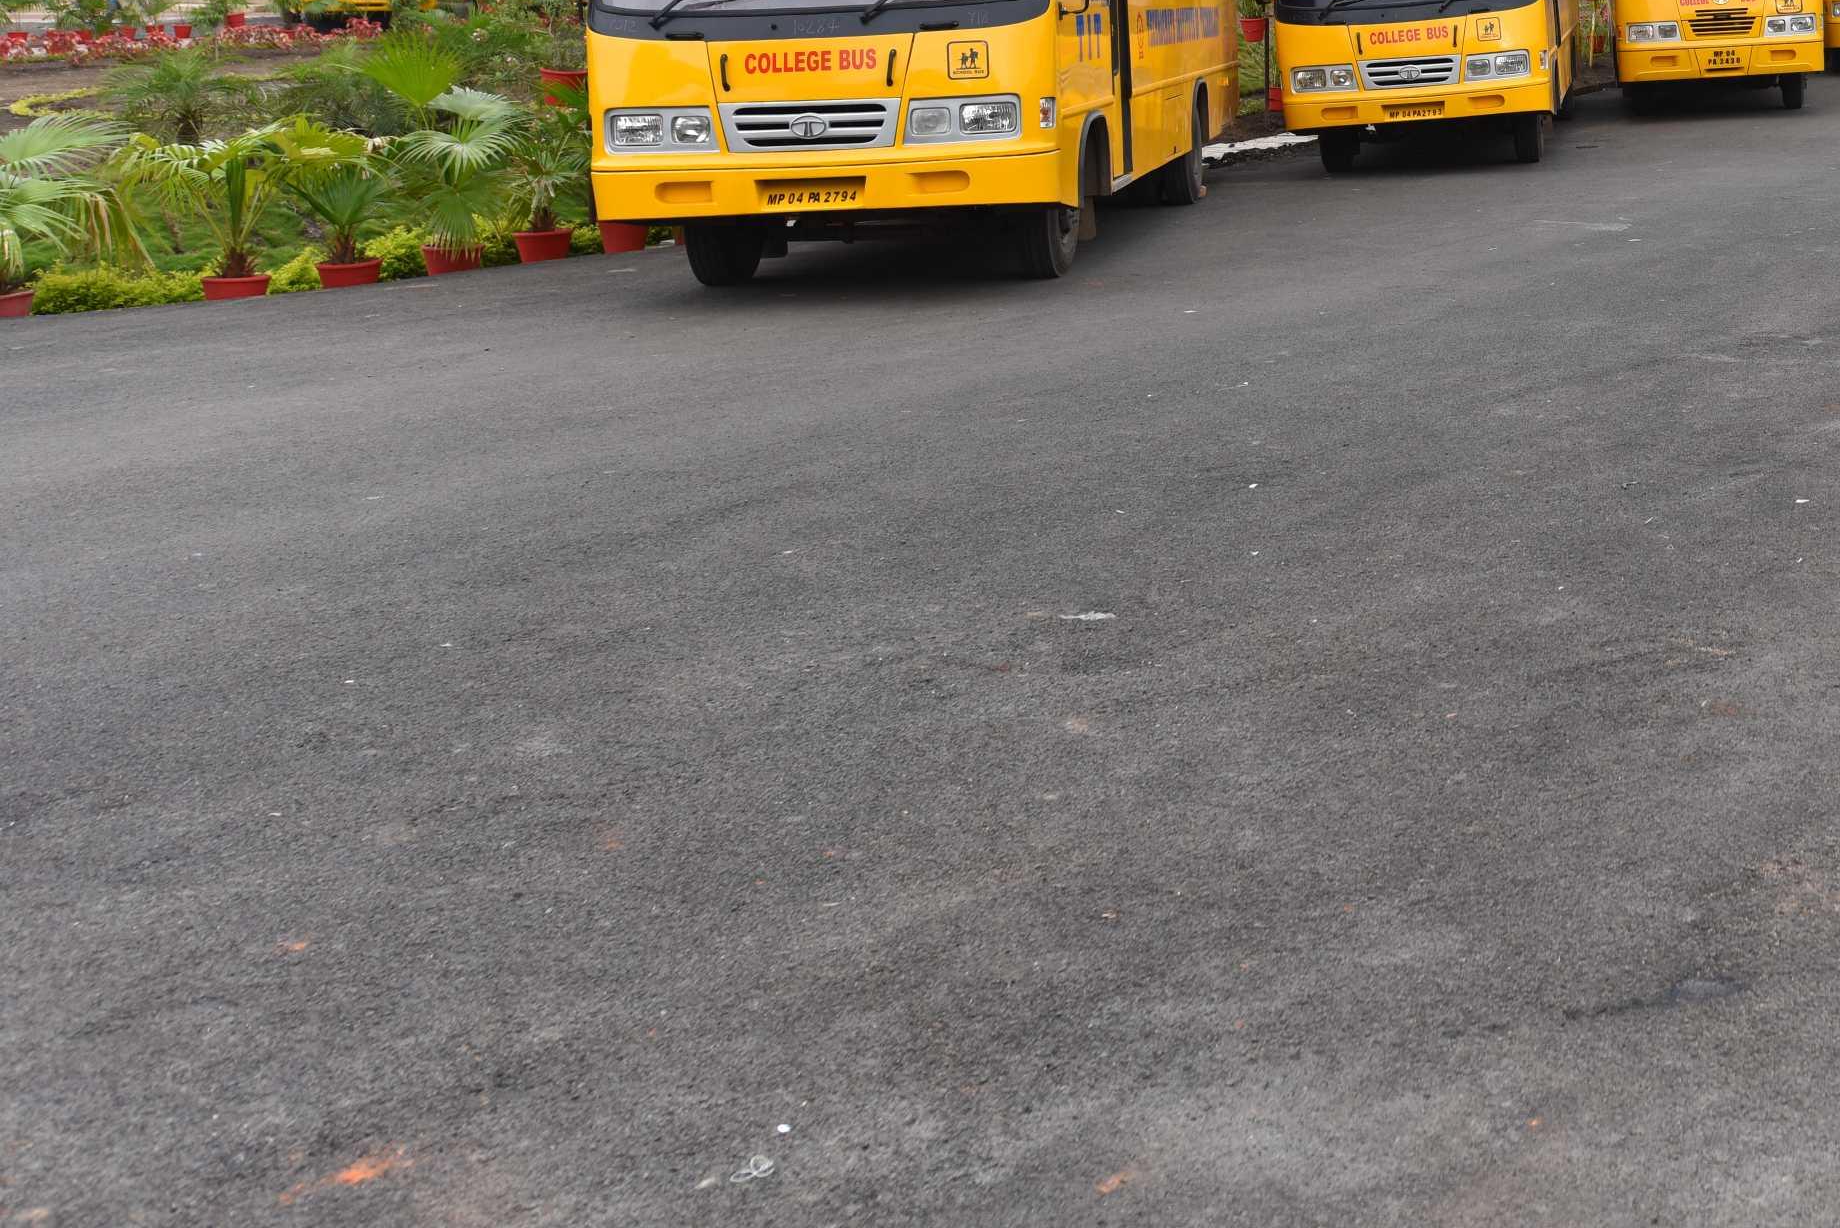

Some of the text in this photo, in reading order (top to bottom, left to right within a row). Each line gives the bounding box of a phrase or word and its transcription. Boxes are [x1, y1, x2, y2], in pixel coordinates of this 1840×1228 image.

[1076, 13, 1102, 62] TIT
[1369, 25, 1449, 45] COLLEGE BUS
[744, 48, 878, 74] COLLEGE BUS
[1389, 111, 1400, 119] MP
[767, 190, 857, 206] MP 04 PA 2794
